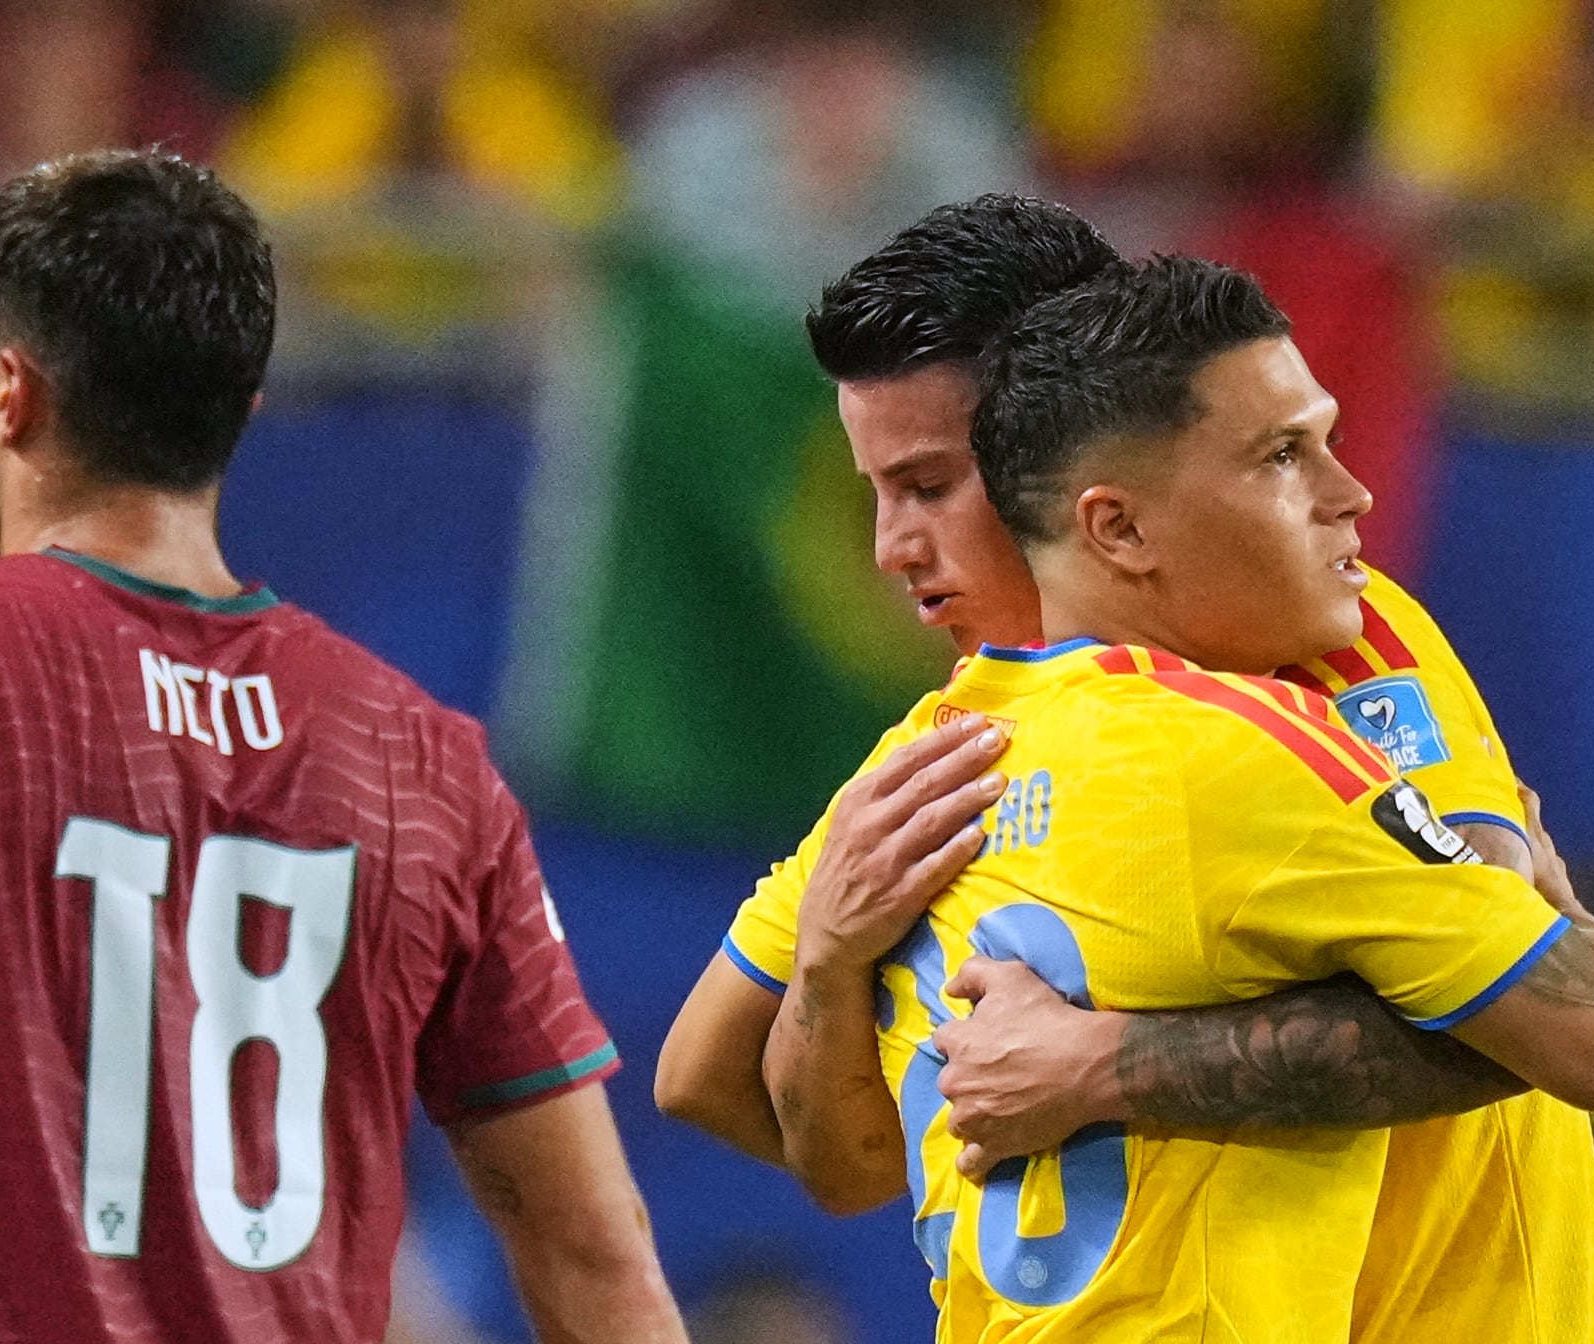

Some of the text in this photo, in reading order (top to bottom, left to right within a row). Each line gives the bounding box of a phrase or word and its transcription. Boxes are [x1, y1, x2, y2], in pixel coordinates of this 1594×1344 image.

[139, 648, 284, 756] NETO
[1391, 745, 1423, 767] ACE
[54, 815, 359, 1273] 18
